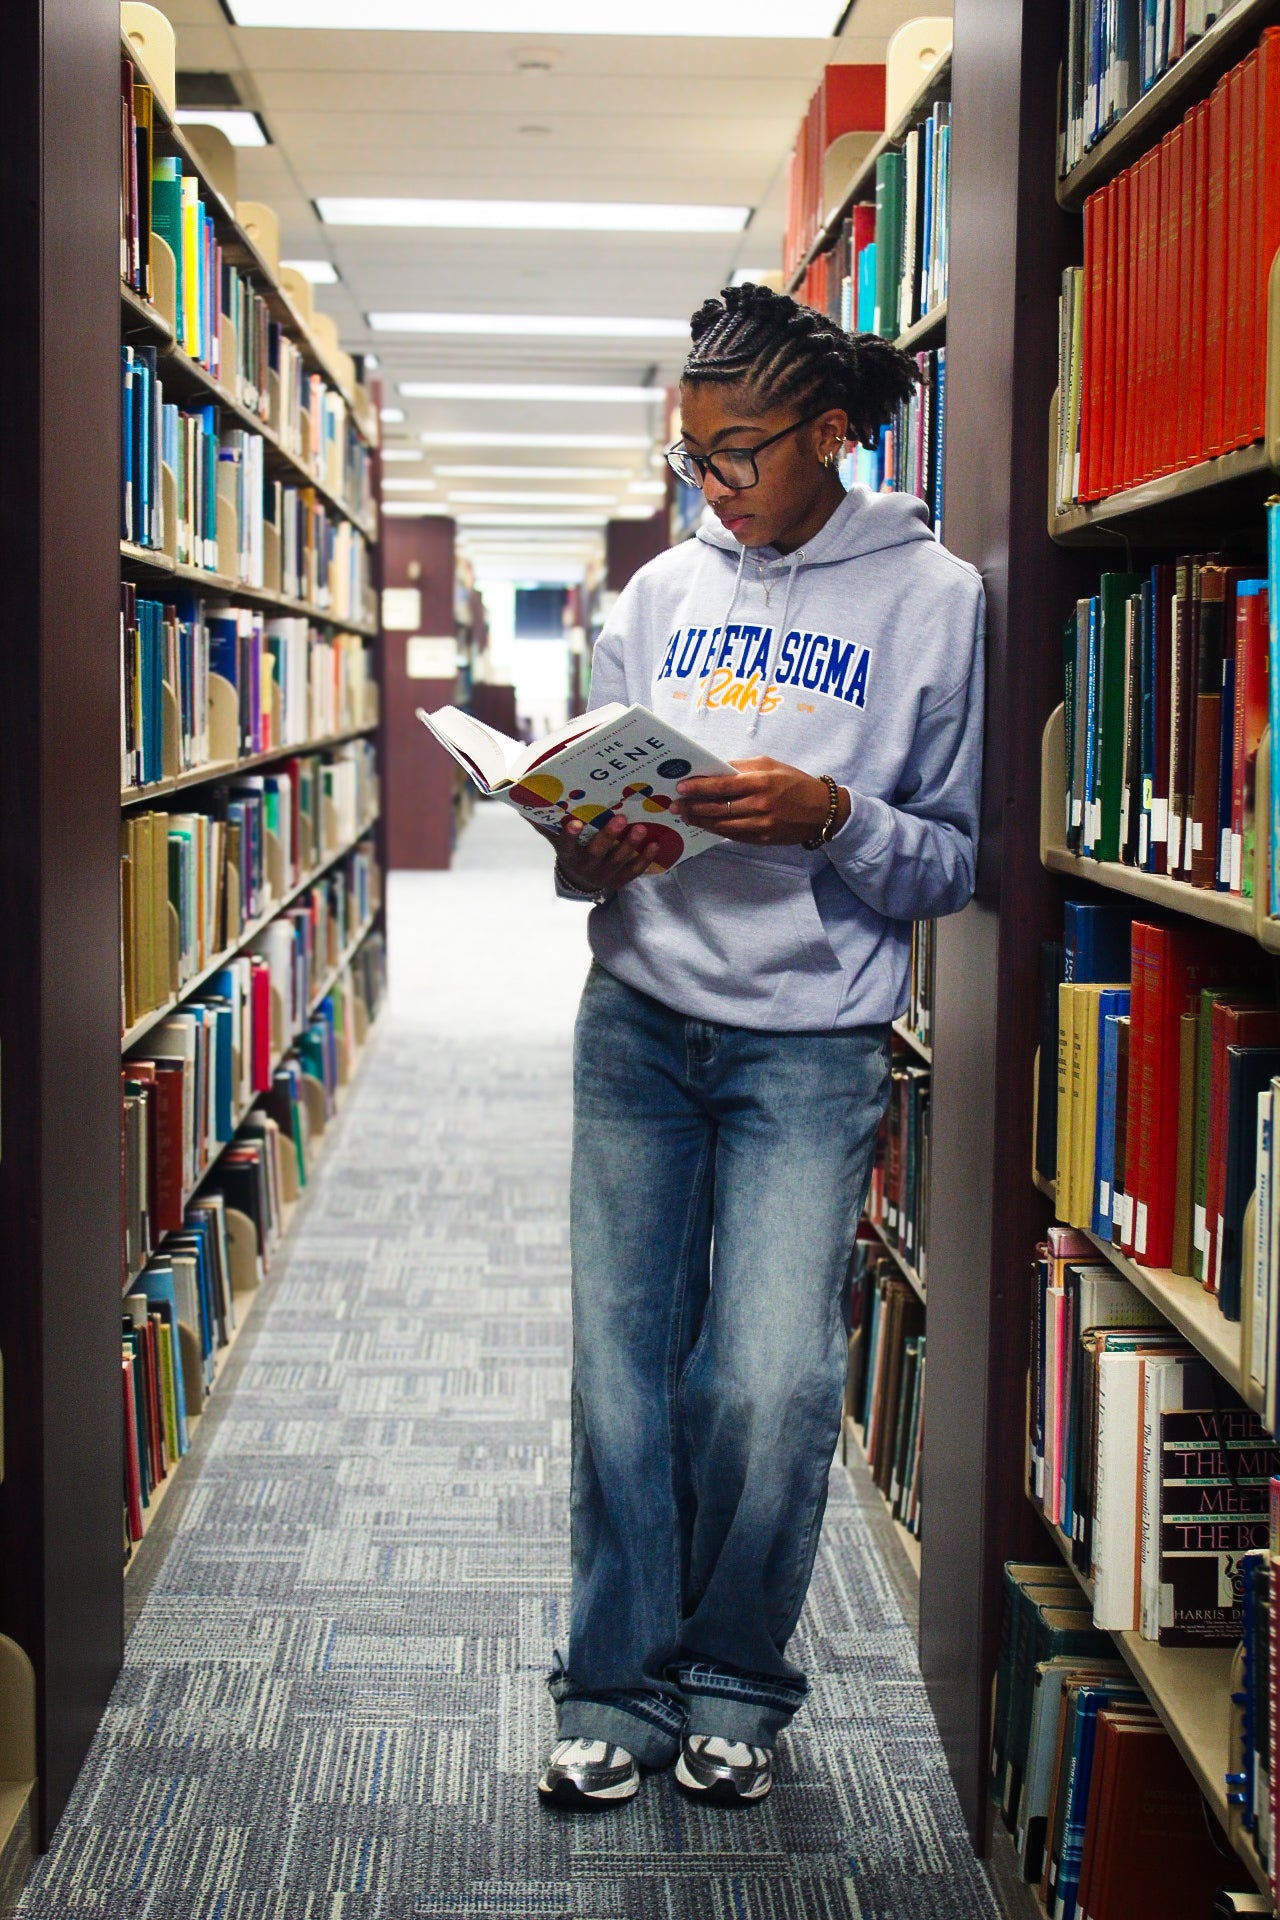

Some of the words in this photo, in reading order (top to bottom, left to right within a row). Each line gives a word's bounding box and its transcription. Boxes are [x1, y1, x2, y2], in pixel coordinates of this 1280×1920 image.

[935, 385, 945, 518] PATHOPHYSIOLOGY
[775, 631, 871, 709] SIGMA
[589, 736, 666, 781] GENE
[595, 740, 624, 758] THE
[646, 749, 671, 765] HISTORY
[1143, 1424, 1152, 1445] The
[1175, 1452, 1229, 1476] THE
[1238, 1452, 1280, 1475] MIN
[1141, 1446, 1151, 1519] Psychosomatic
[1139, 1520, 1151, 1564] Delusion
[1175, 1525, 1230, 1549] THE
[1237, 1525, 1271, 1549] BO
[1174, 1609, 1225, 1621] HARRIS
